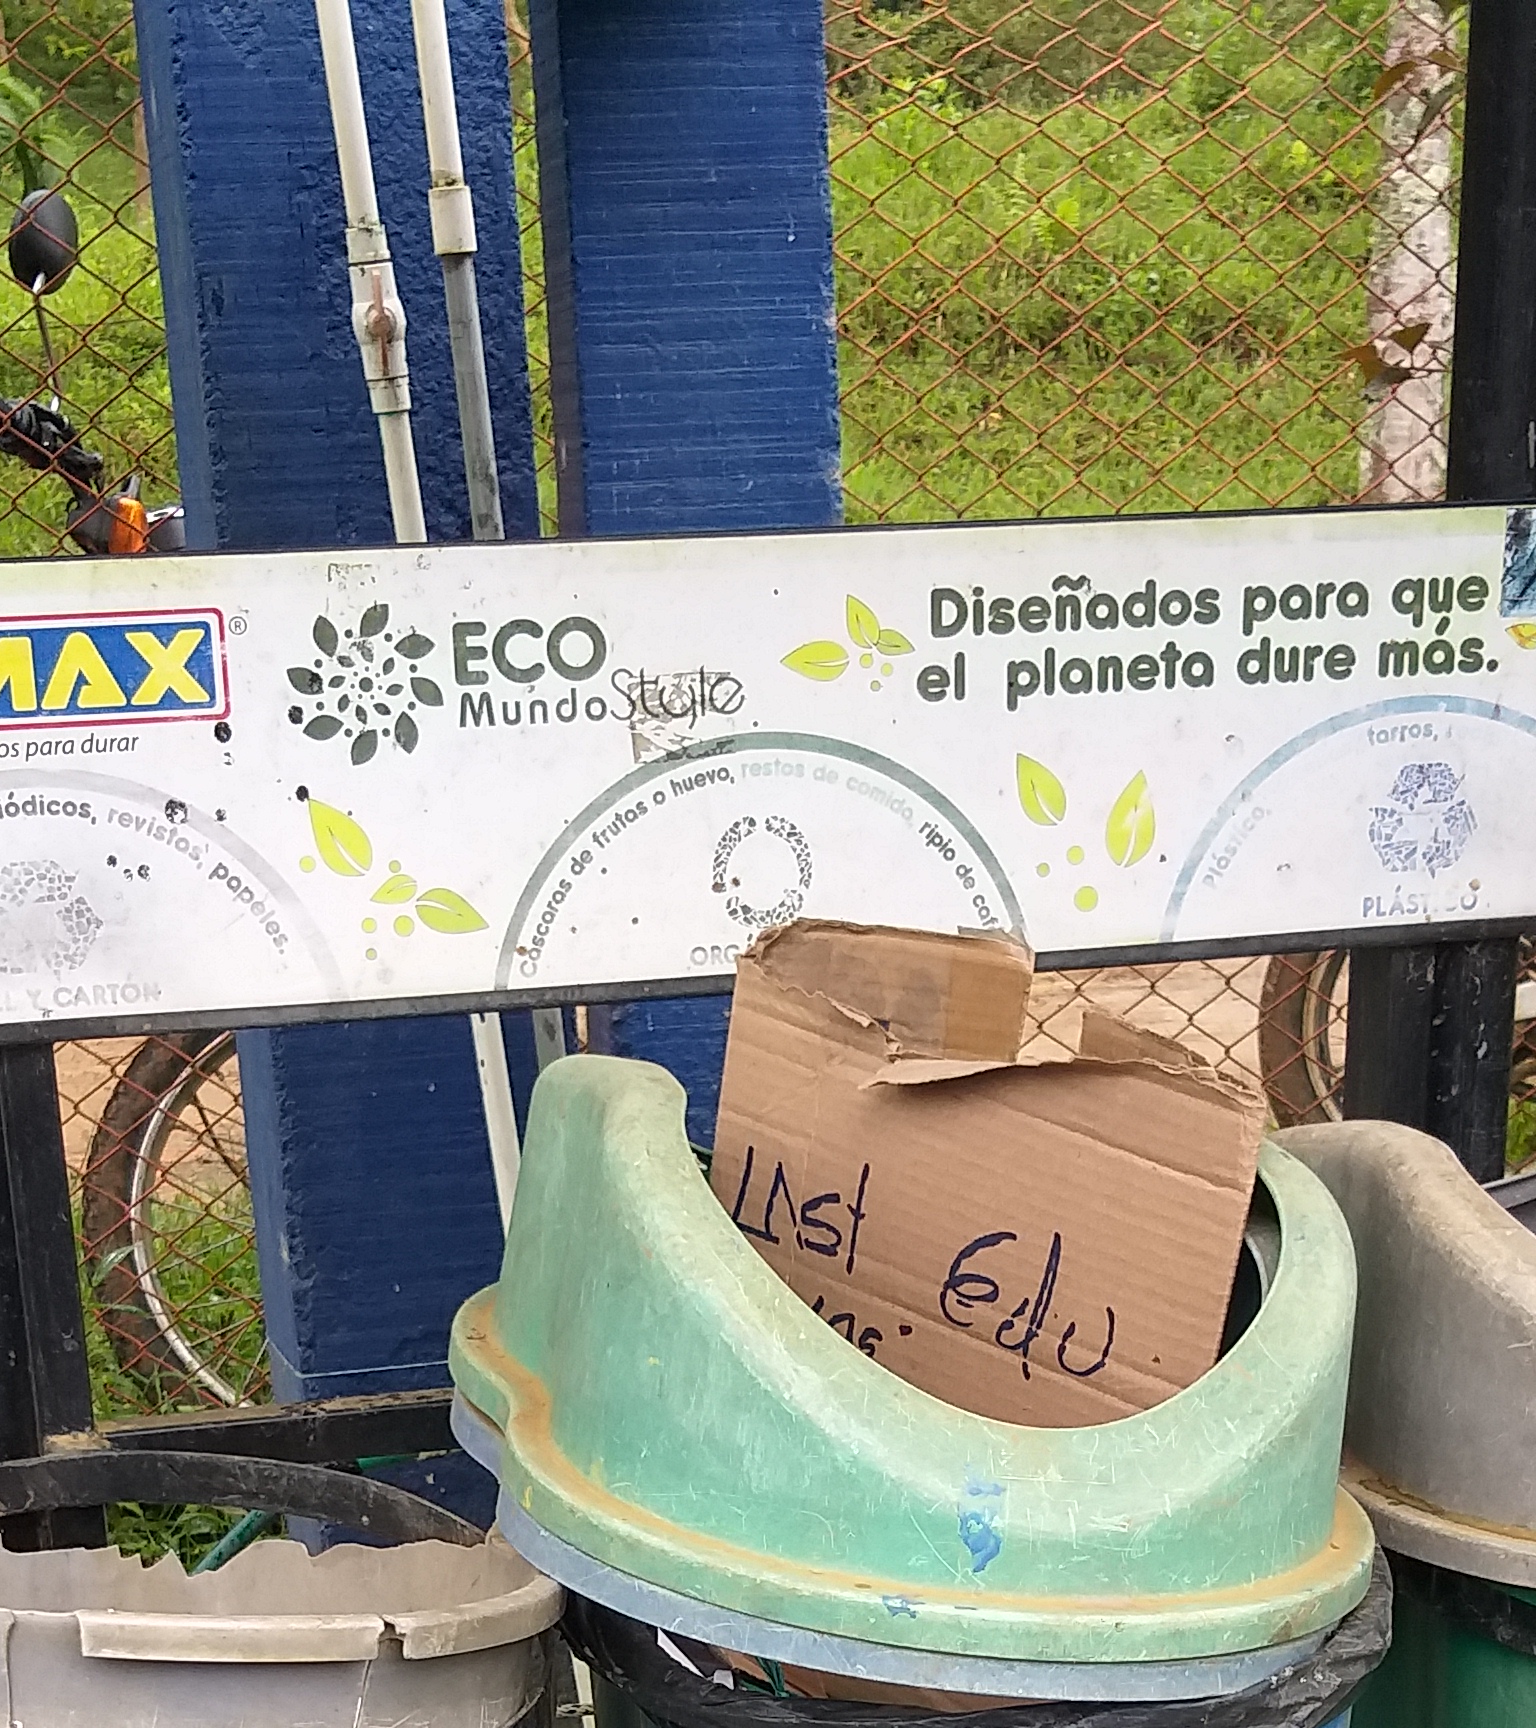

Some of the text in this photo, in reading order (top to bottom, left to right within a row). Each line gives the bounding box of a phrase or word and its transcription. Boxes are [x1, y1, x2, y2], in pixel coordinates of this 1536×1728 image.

[930, 575, 1488, 638] Diseñados para que
[452, 616, 607, 686] ECO
[917, 617, 1499, 711] el planeta dure más.
[25, 741, 76, 760] para
[80, 733, 139, 755] durar
[1367, 722, 1438, 746] tarros,
[571, 850, 594, 875] de
[592, 801, 648, 848] frutas
[652, 790, 666, 806] o
[670, 766, 735, 797] huevo,
[740, 757, 805, 779] restos
[813, 763, 839, 784] de
[918, 821, 957, 862] ripio
[955, 863, 976, 890] de
[972, 894, 1000, 927] caf
[107, 808, 204, 870] revistas,
[208, 862, 289, 954] papeles.
[1362, 885, 1478, 918] PLÁSTO
